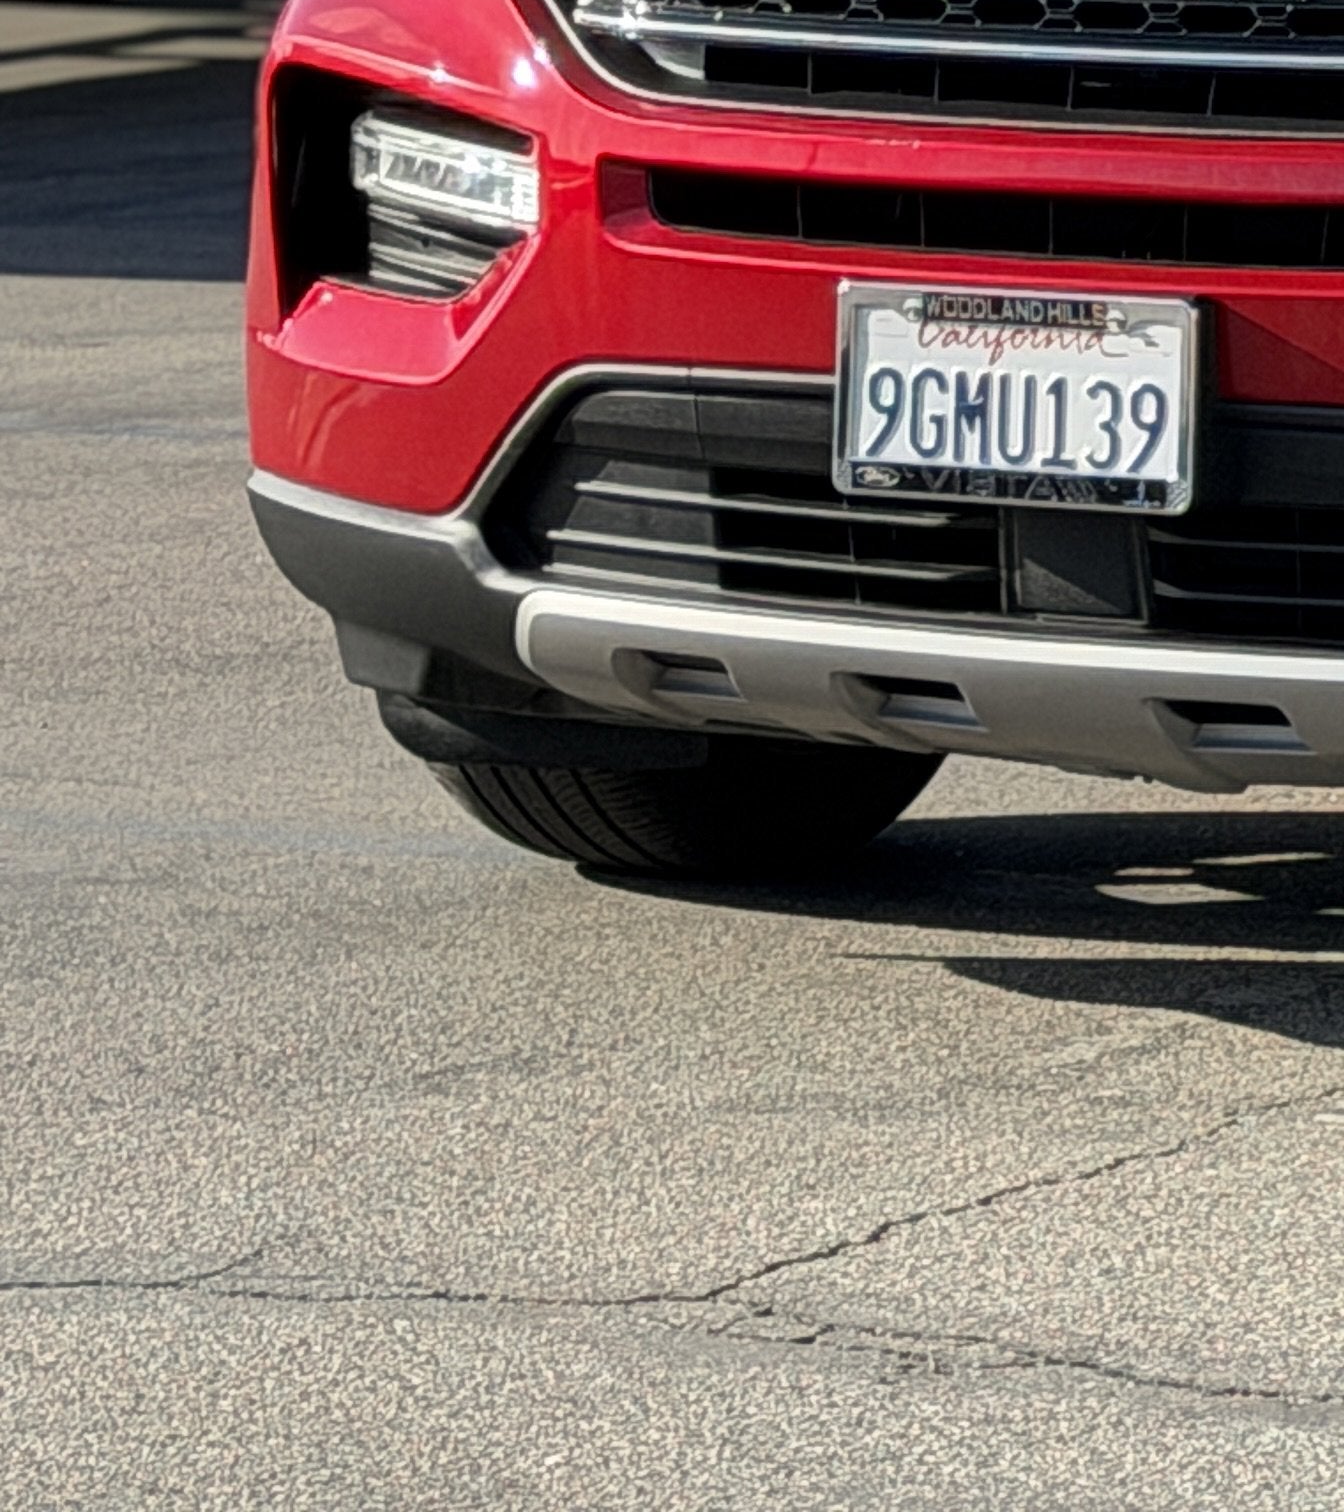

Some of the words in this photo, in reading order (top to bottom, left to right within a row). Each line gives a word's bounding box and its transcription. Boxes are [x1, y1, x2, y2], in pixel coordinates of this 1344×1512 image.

[926, 295, 1045, 323] WOODLAND
[1047, 301, 1106, 326] HILLS
[864, 367, 1170, 473] 9GMU139
